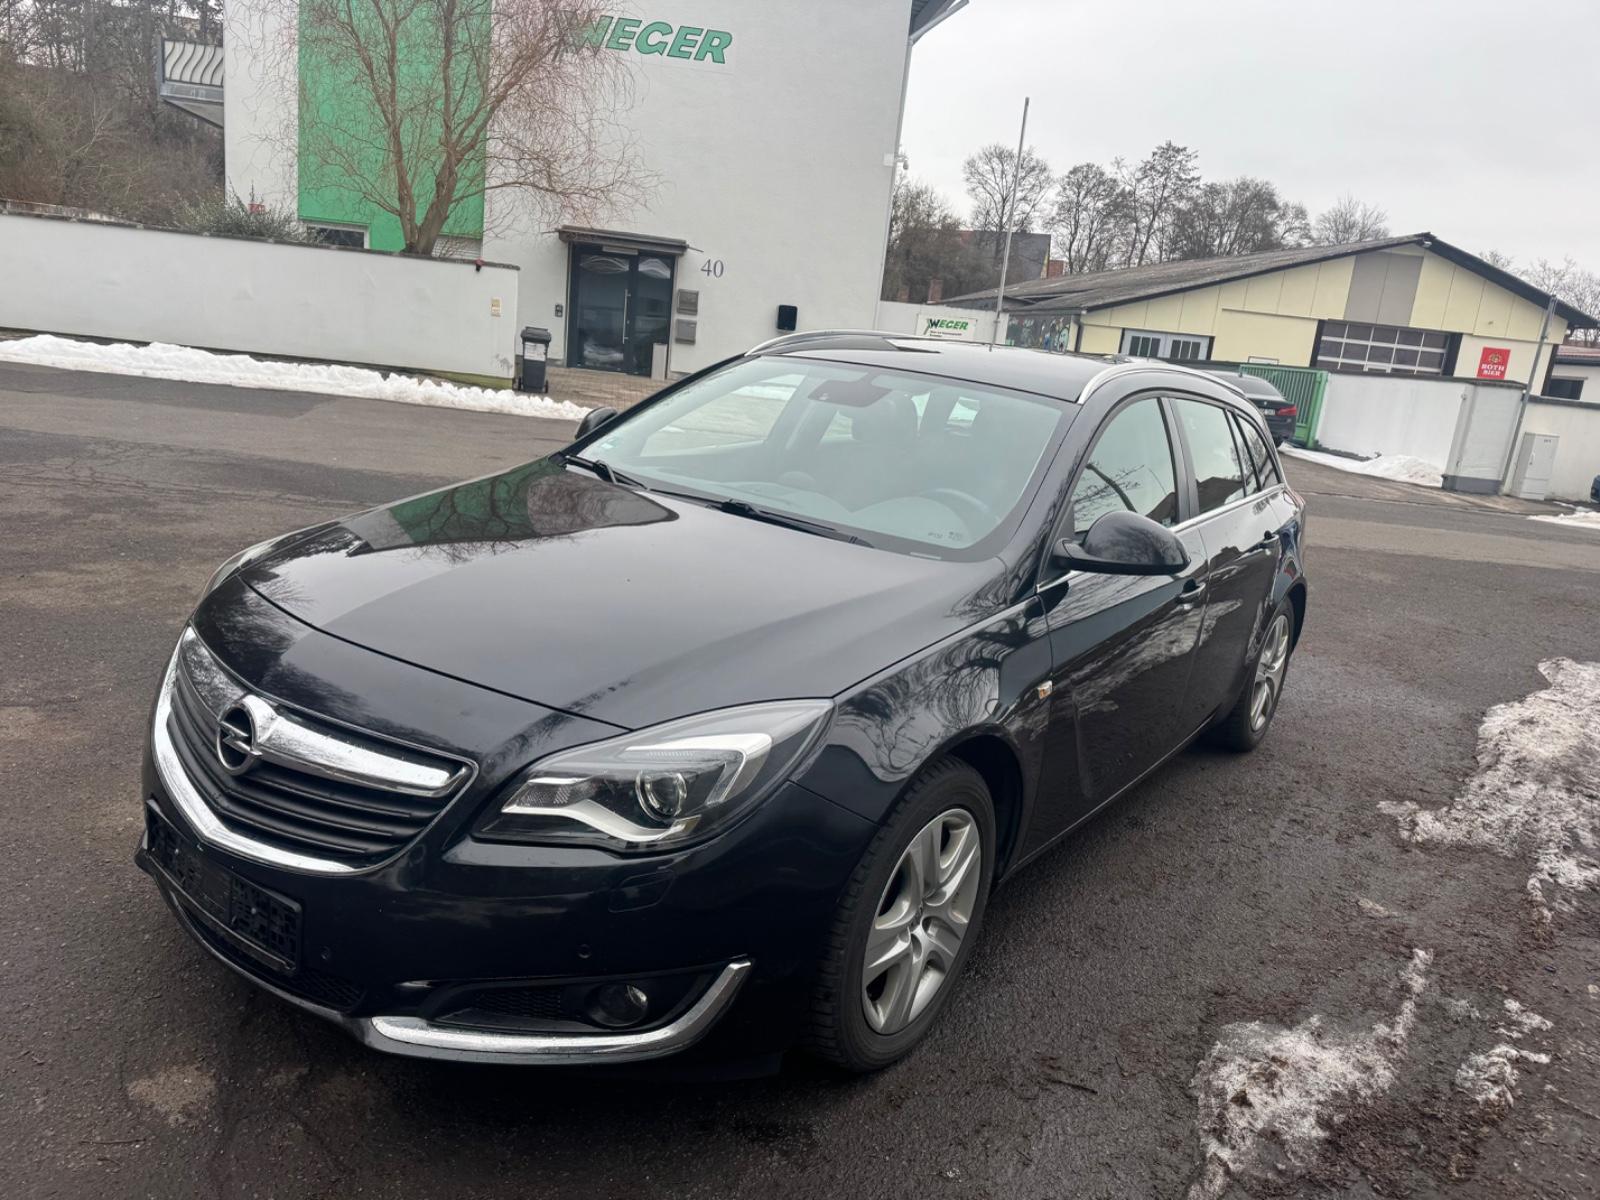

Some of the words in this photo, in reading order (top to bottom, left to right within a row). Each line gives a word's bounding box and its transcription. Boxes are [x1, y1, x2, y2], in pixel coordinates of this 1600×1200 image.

[564, 13, 733, 64] WEGER
[700, 258, 725, 278] 40
[929, 319, 969, 330] WEGER
